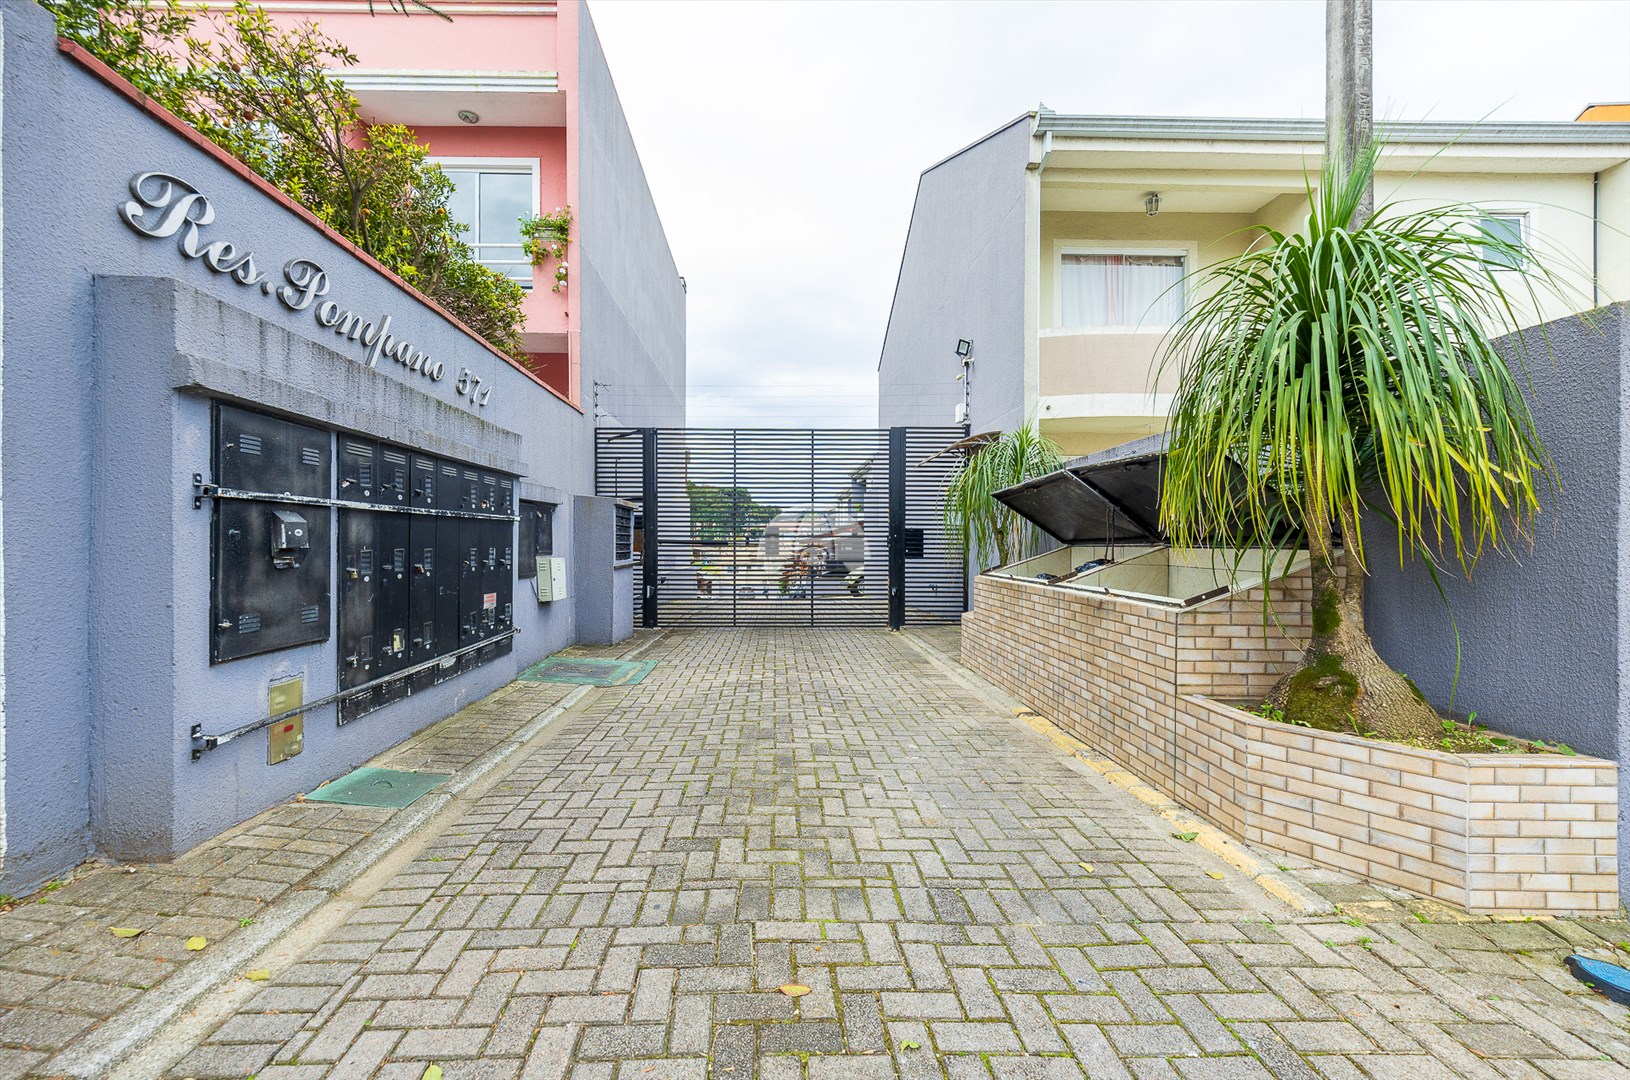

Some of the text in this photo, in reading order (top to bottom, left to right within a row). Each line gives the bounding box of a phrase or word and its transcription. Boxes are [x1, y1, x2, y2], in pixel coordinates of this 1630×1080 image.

[117, 171, 492, 406] Res. Pompano 571
